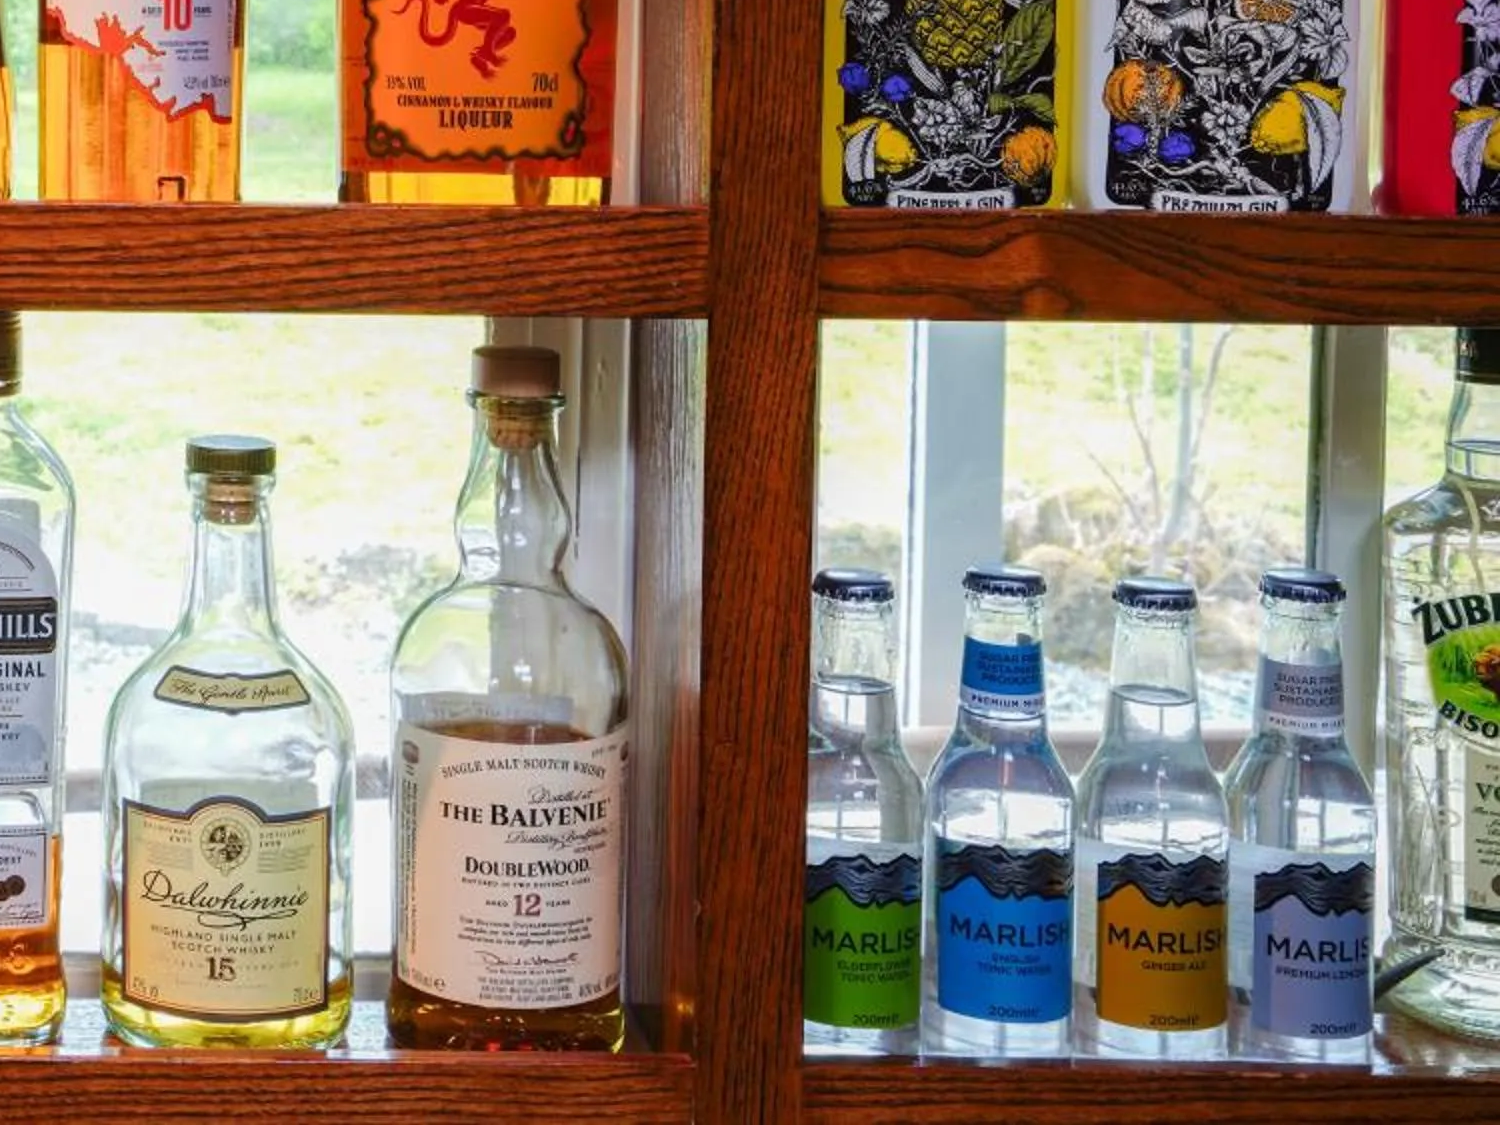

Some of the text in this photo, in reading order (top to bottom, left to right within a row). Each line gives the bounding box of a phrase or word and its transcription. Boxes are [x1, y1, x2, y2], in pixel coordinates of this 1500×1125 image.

[397, 94, 452, 108] CINNAMON
[438, 109, 514, 131] LIQUEUR
[977, 195, 1005, 208] GIN
[1248, 199, 1279, 212] GIN
[441, 758, 570, 779] SINGLE MALT SCOTCH
[439, 800, 608, 827] THE BALVENIE
[464, 855, 591, 877] DOUBLEWOOD
[141, 869, 312, 911] Dalwhinnie
[513, 893, 543, 917] 12
[151, 924, 298, 943] HIGHLAND SINGLE MALT
[171, 942, 276, 955] SCOTCH WHISKY
[205, 955, 237, 982] 15
[1141, 960, 1186, 972] GINGER
